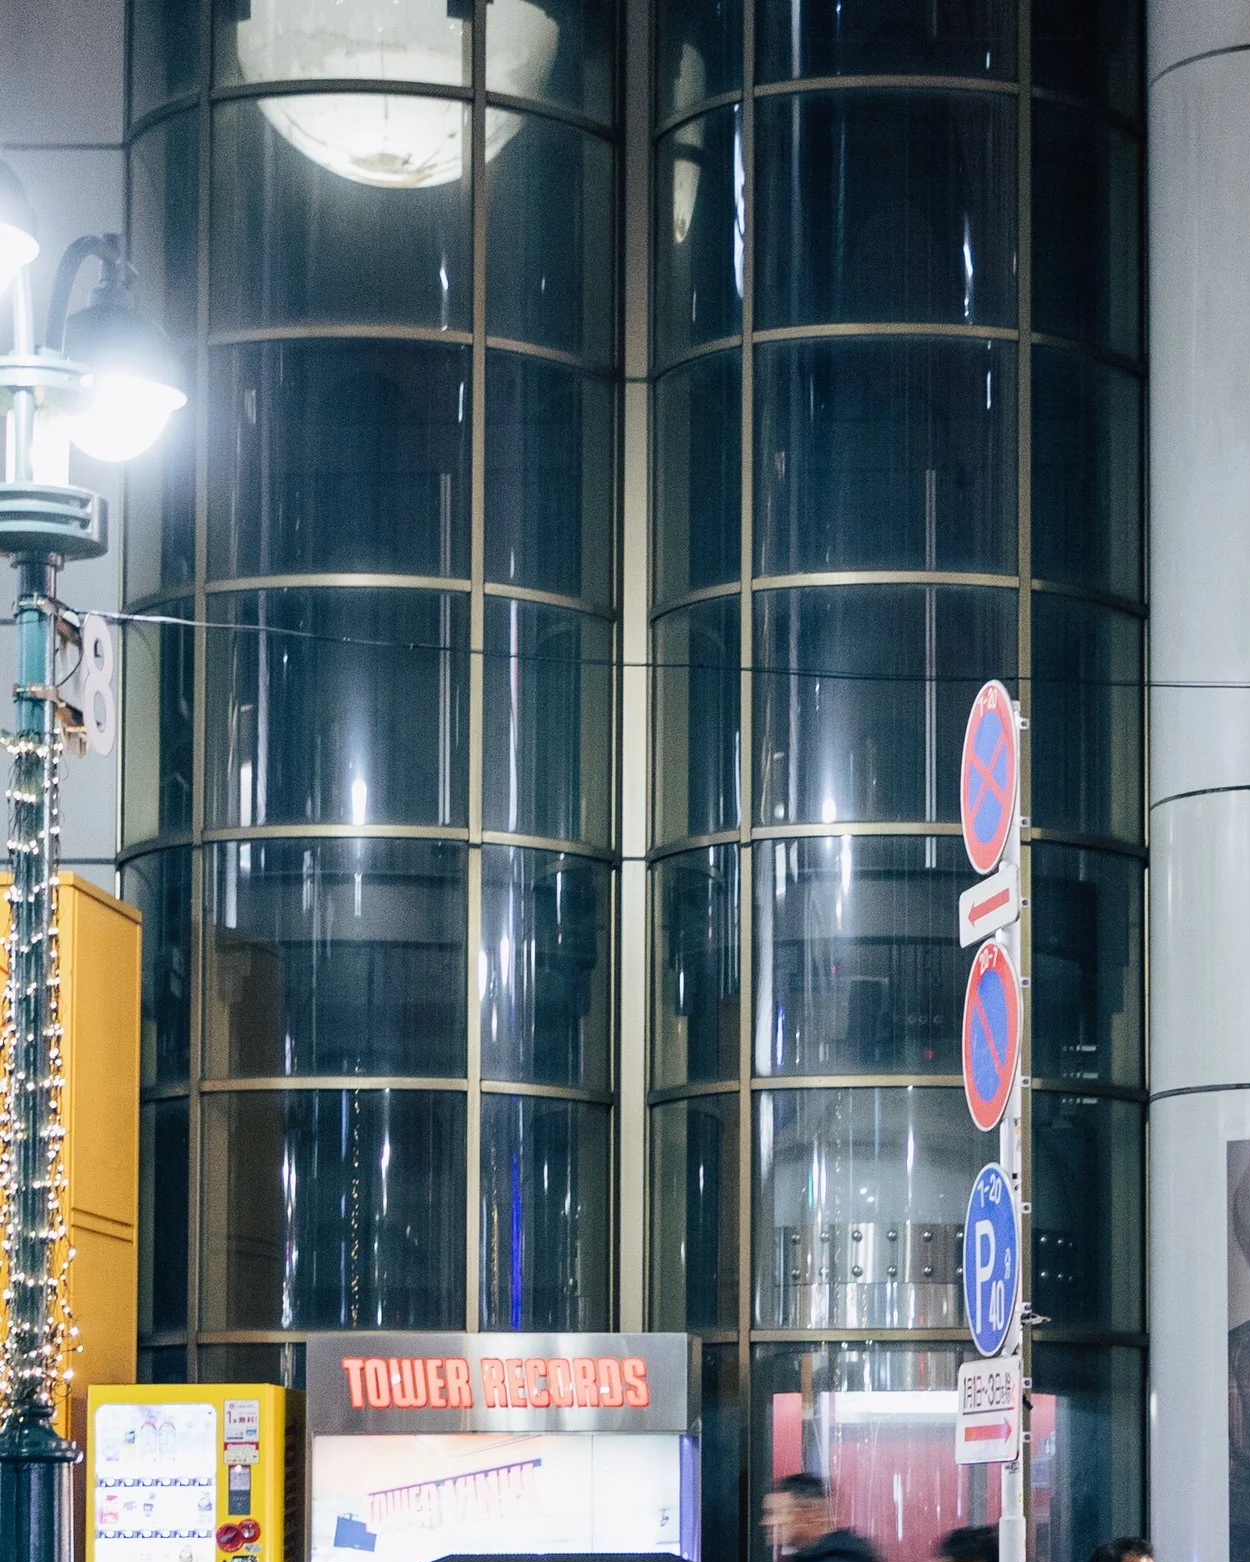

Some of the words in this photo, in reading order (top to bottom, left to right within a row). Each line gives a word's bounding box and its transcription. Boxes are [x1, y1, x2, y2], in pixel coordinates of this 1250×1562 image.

[975, 1219, 996, 1334] P
[342, 1356, 473, 1409] TOWER
[480, 1356, 651, 1409] RECORDS
